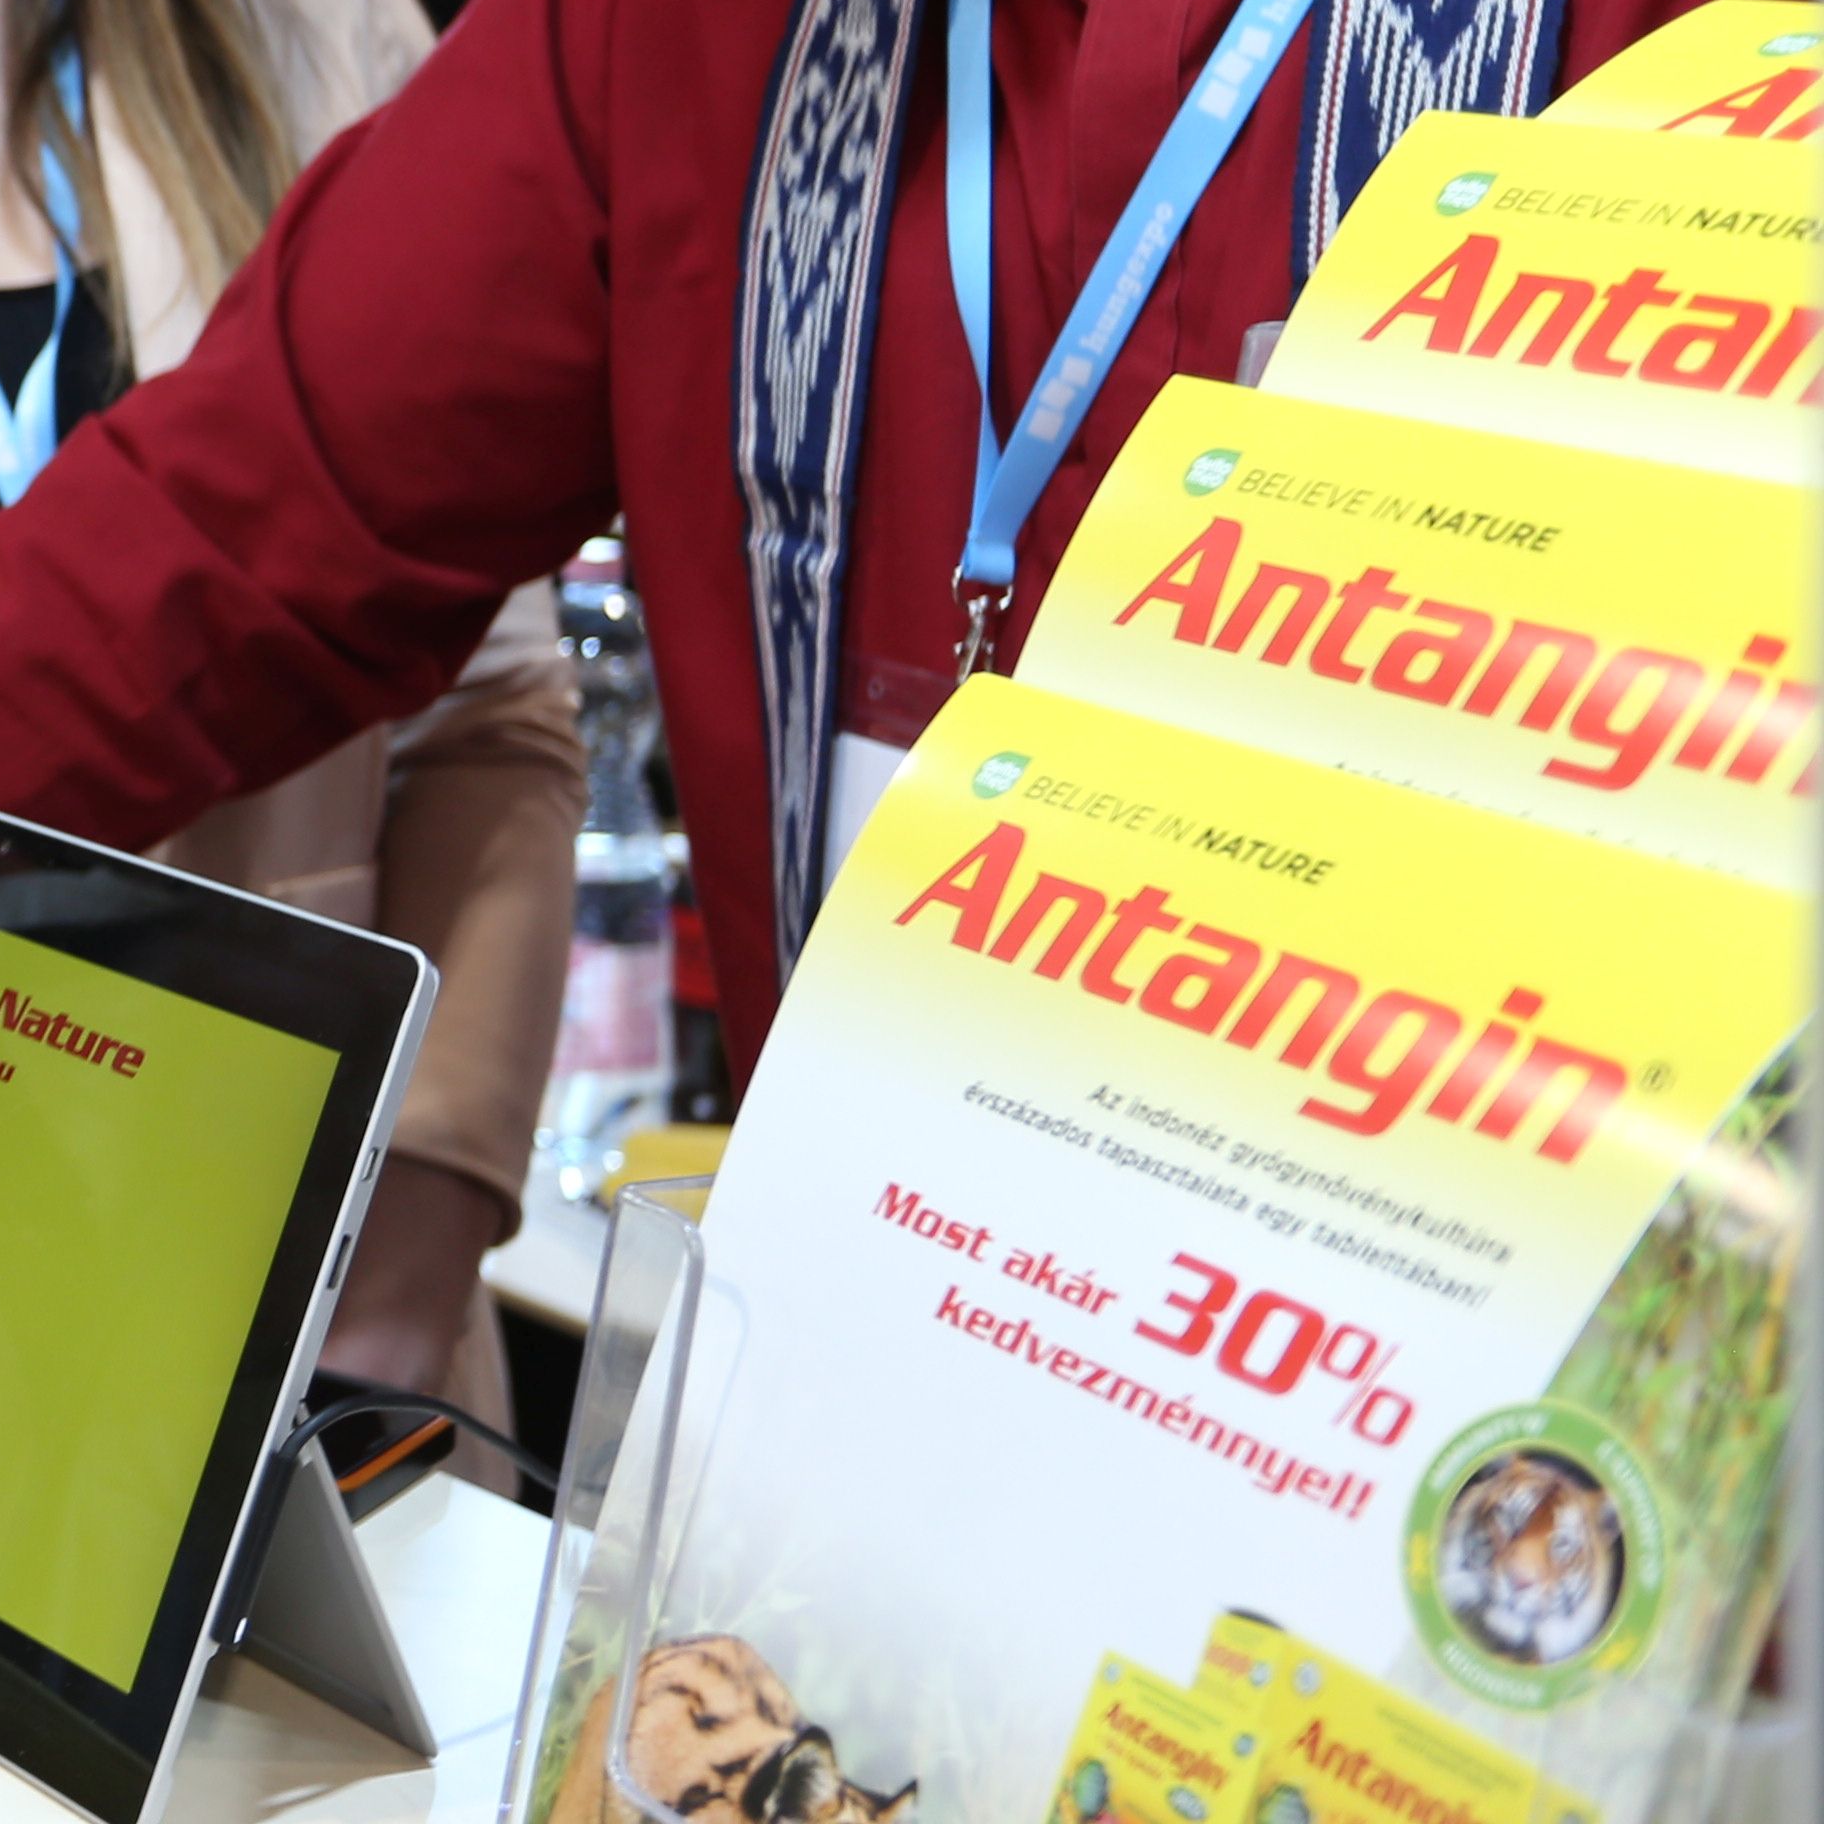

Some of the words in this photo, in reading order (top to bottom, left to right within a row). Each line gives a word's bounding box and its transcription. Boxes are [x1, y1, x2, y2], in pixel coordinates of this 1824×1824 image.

[1081, 201, 1175, 355] hungexpo
[1494, 186, 1641, 224] BELIEVE
[1638, 202, 1683, 226] IN
[1237, 467, 1373, 523] BELIEVE
[1372, 494, 1416, 524] IN
[1414, 503, 1562, 553] NATURE
[1024, 774, 1151, 835] BELIEVE
[1151, 807, 1194, 844] IN
[1191, 825, 1337, 888] NATURE
[893, 819, 1630, 1167] Antangin
[962, 1081, 1093, 1150] évszázados
[1096, 1133, 1252, 1213] tapasztalata
[1254, 1198, 1309, 1234] egy
[1085, 1083, 1123, 1111] Az
[1127, 1095, 1228, 1153] indonéz
[872, 1181, 994, 1263] Most
[1000, 1246, 1119, 1316] akár
[1133, 1250, 1415, 1449] 30%
[934, 1283, 1379, 1520] kedvezménnyel!
